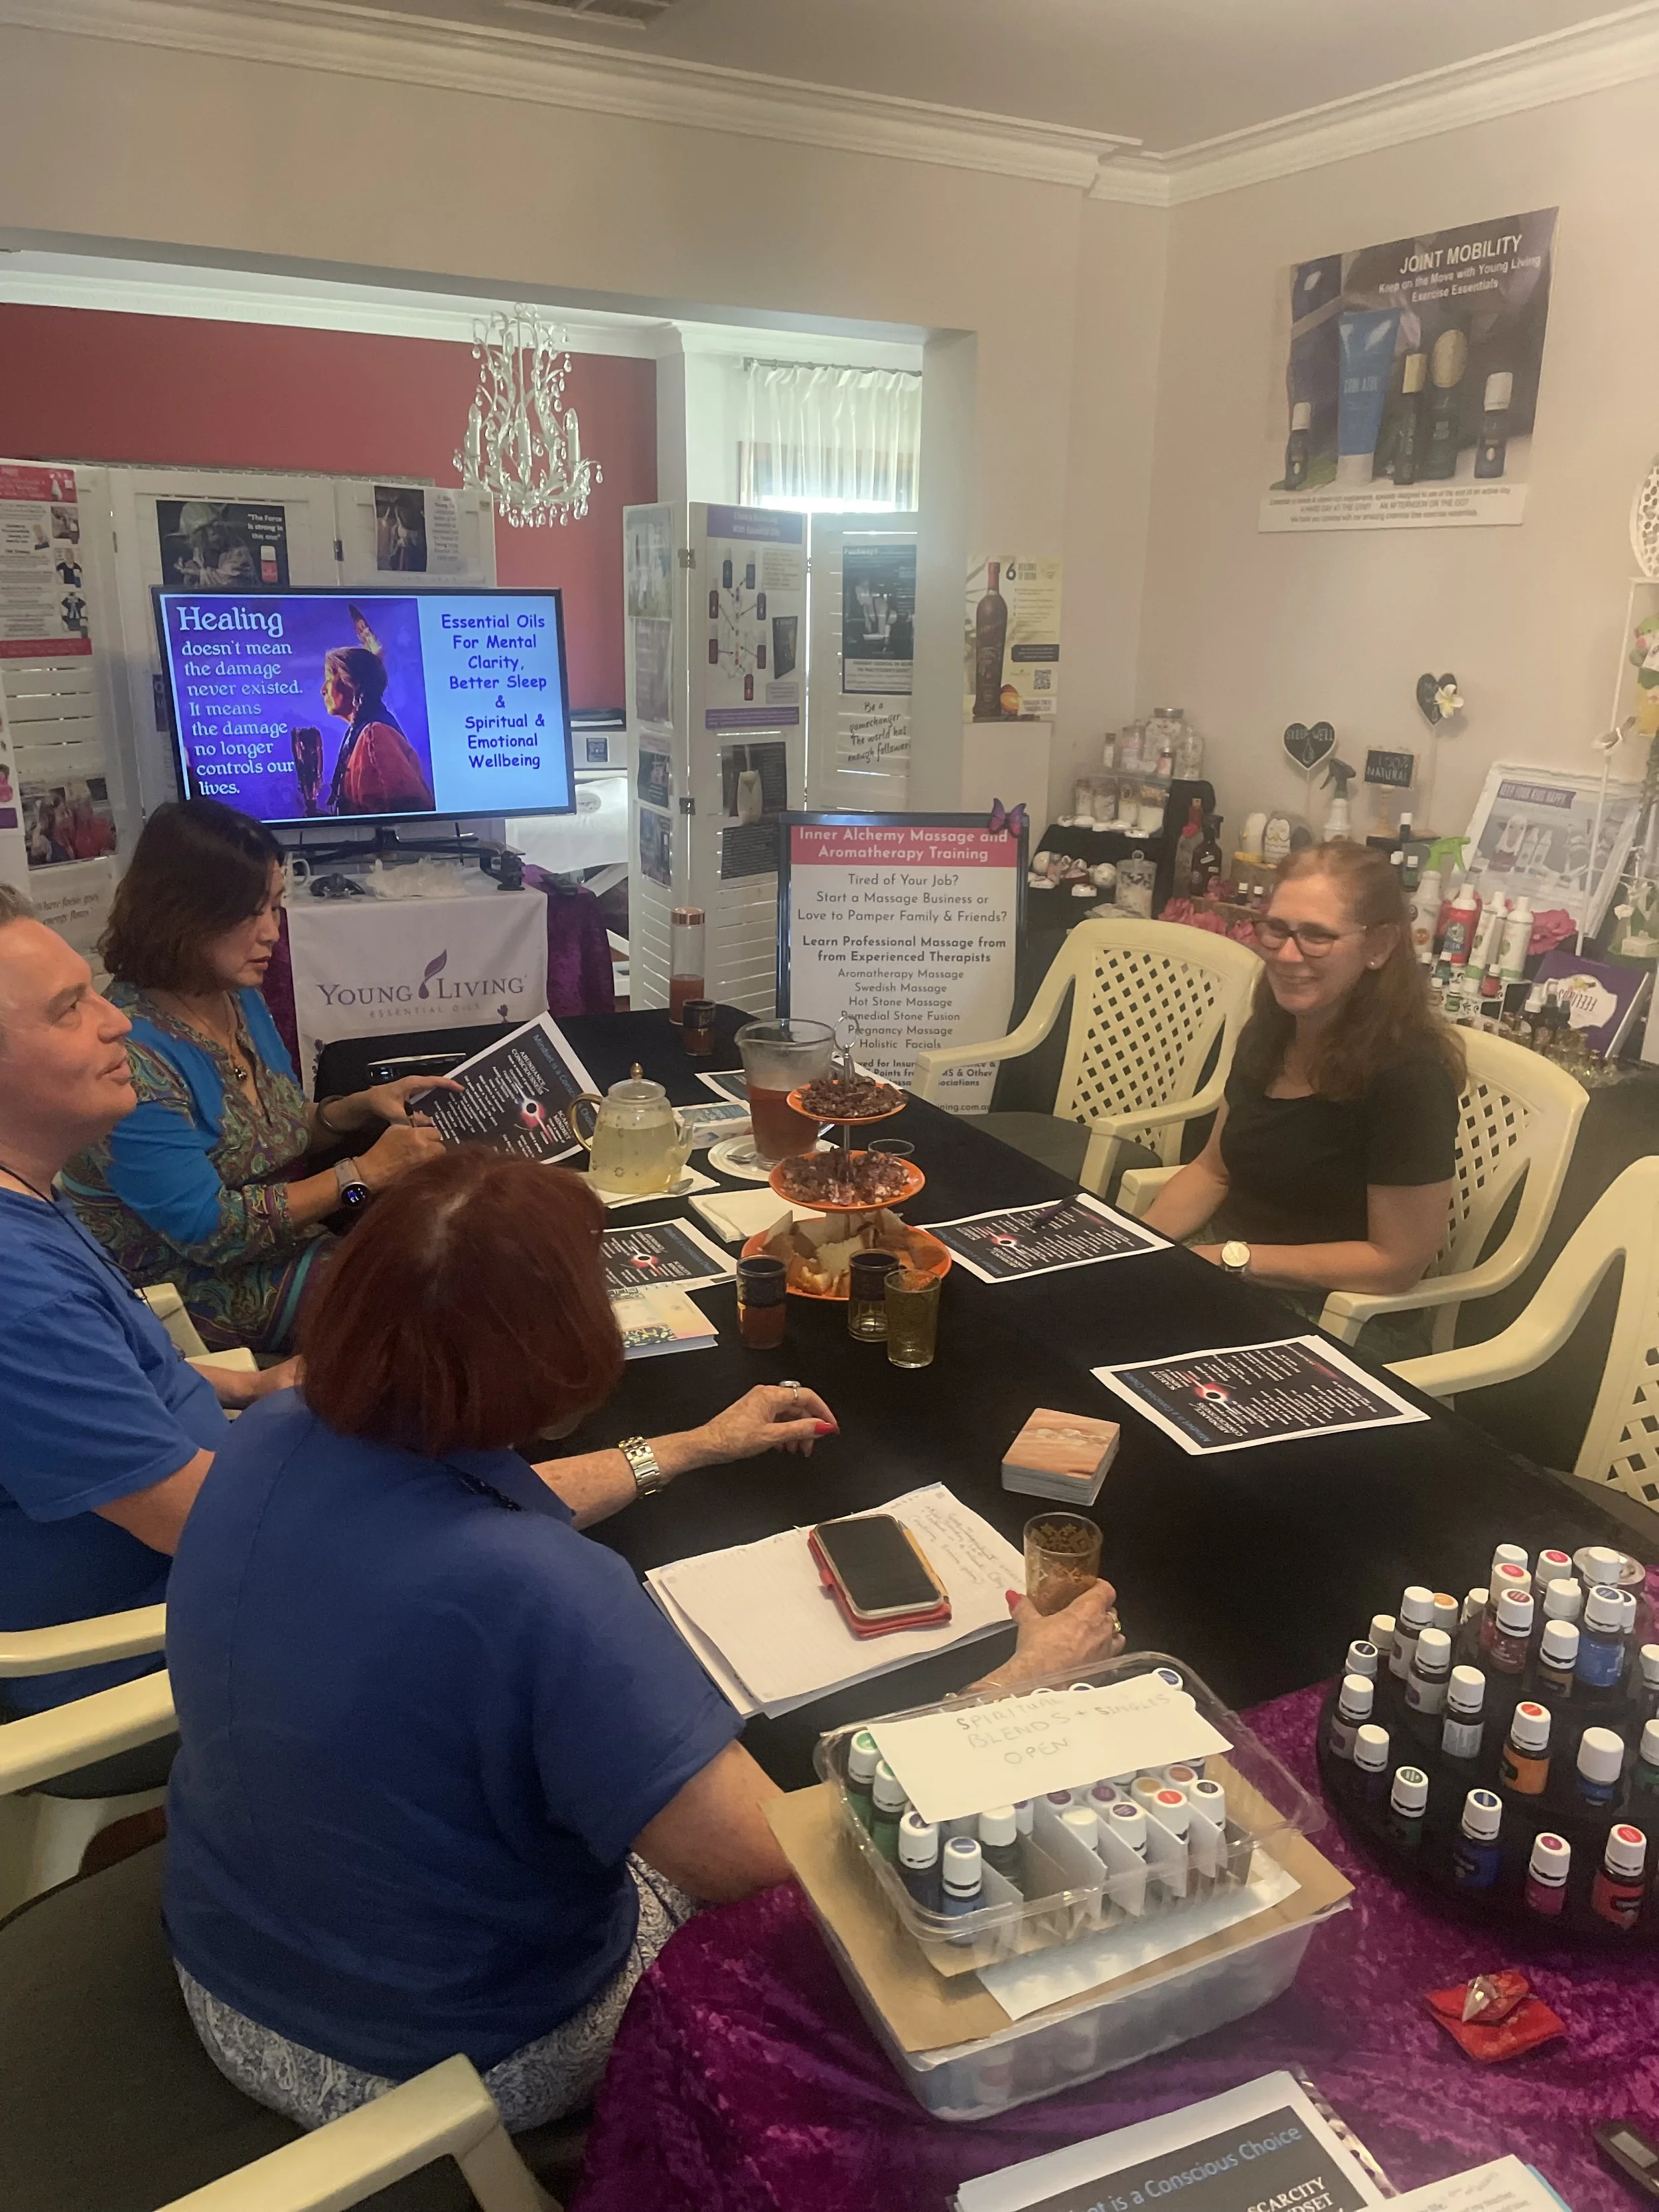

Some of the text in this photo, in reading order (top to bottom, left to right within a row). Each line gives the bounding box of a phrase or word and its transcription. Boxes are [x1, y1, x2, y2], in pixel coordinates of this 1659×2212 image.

[1399, 234, 1522, 274] JOINT MOBILITY
[1415, 276, 1428, 287] the
[1431, 272, 1454, 284] Move
[1457, 267, 1475, 279] with
[1479, 261, 1508, 275] Young
[1511, 256, 1541, 269] Living
[1451, 278, 1498, 295] Essentials
[254, 524, 275, 532] strong
[1006, 563, 1017, 581] 6
[177, 605, 284, 638] Healing
[441, 614, 545, 630] Essential Oils
[181, 639, 293, 656] doesn't mean
[453, 634, 537, 649] For Mental
[184, 661, 281, 679] the damage
[468, 655, 525, 671] Clarity,
[186, 680, 303, 696] never existed.
[449, 675, 547, 692] Better Sleep
[188, 701, 261, 716] It means
[495, 695, 506, 709] &
[864, 701, 875, 713] Be
[192, 721, 288, 738] the damage
[465, 713, 545, 731] Spiritual &
[849, 713, 901, 733] gamechanger
[468, 734, 538, 749] Emotional
[868, 728, 891, 742] world
[194, 740, 274, 759] no longer
[848, 747, 874, 763] enough
[196, 760, 295, 776] controls our
[469, 754, 541, 770] Wellbeing
[1367, 766, 1408, 780] NATURAL
[198, 780, 240, 796] lives.
[800, 827, 1008, 845] Inner Alchemy Massage and
[818, 845, 988, 862] Aromatherapy Training
[847, 873, 958, 887] Tired of Your Job?
[816, 891, 847, 903] Start
[864, 893, 918, 905] Massage
[923, 893, 972, 904] Business
[798, 909, 1007, 924] Love to Pamper Family & Friends?
[802, 936, 1006, 950] Learn Professional Massage from
[818, 950, 991, 964] from Experienced Therapists
[837, 968, 964, 980] Aromatherapy Massage
[317, 976, 524, 1005] YOUNG LIVING
[854, 982, 947, 994] Swedish Massage
[849, 997, 952, 1009] Hot Stone Massage
[370, 1005, 443, 1018] ESSENTIAL
[894, 1011, 922, 1021] Stone
[928, 1011, 960, 1021] Fusion
[847, 1025, 953, 1037] Pregnancy Massage
[532, 1033, 555, 1063] Mindset
[550, 1061, 559, 1070] is
[859, 1039, 941, 1049] Holistic Facials
[510, 1047, 543, 1096] CONSCIOUSNESS
[519, 1049, 545, 1088] ABUNDANCE
[552, 1114, 571, 1140] MINDSET
[956, 1696, 1064, 1730] SPIRITUAL
[968, 1713, 1070, 1749] BLENDS
[1094, 1694, 1171, 1715] SINGLES
[1003, 1737, 1069, 1765] OPEN
[1108, 2195, 1128, 2212] is
[1129, 2190, 1145, 2205] a
[1144, 2153, 1239, 2197] Conscious
[1238, 2126, 1303, 2160] Choice
